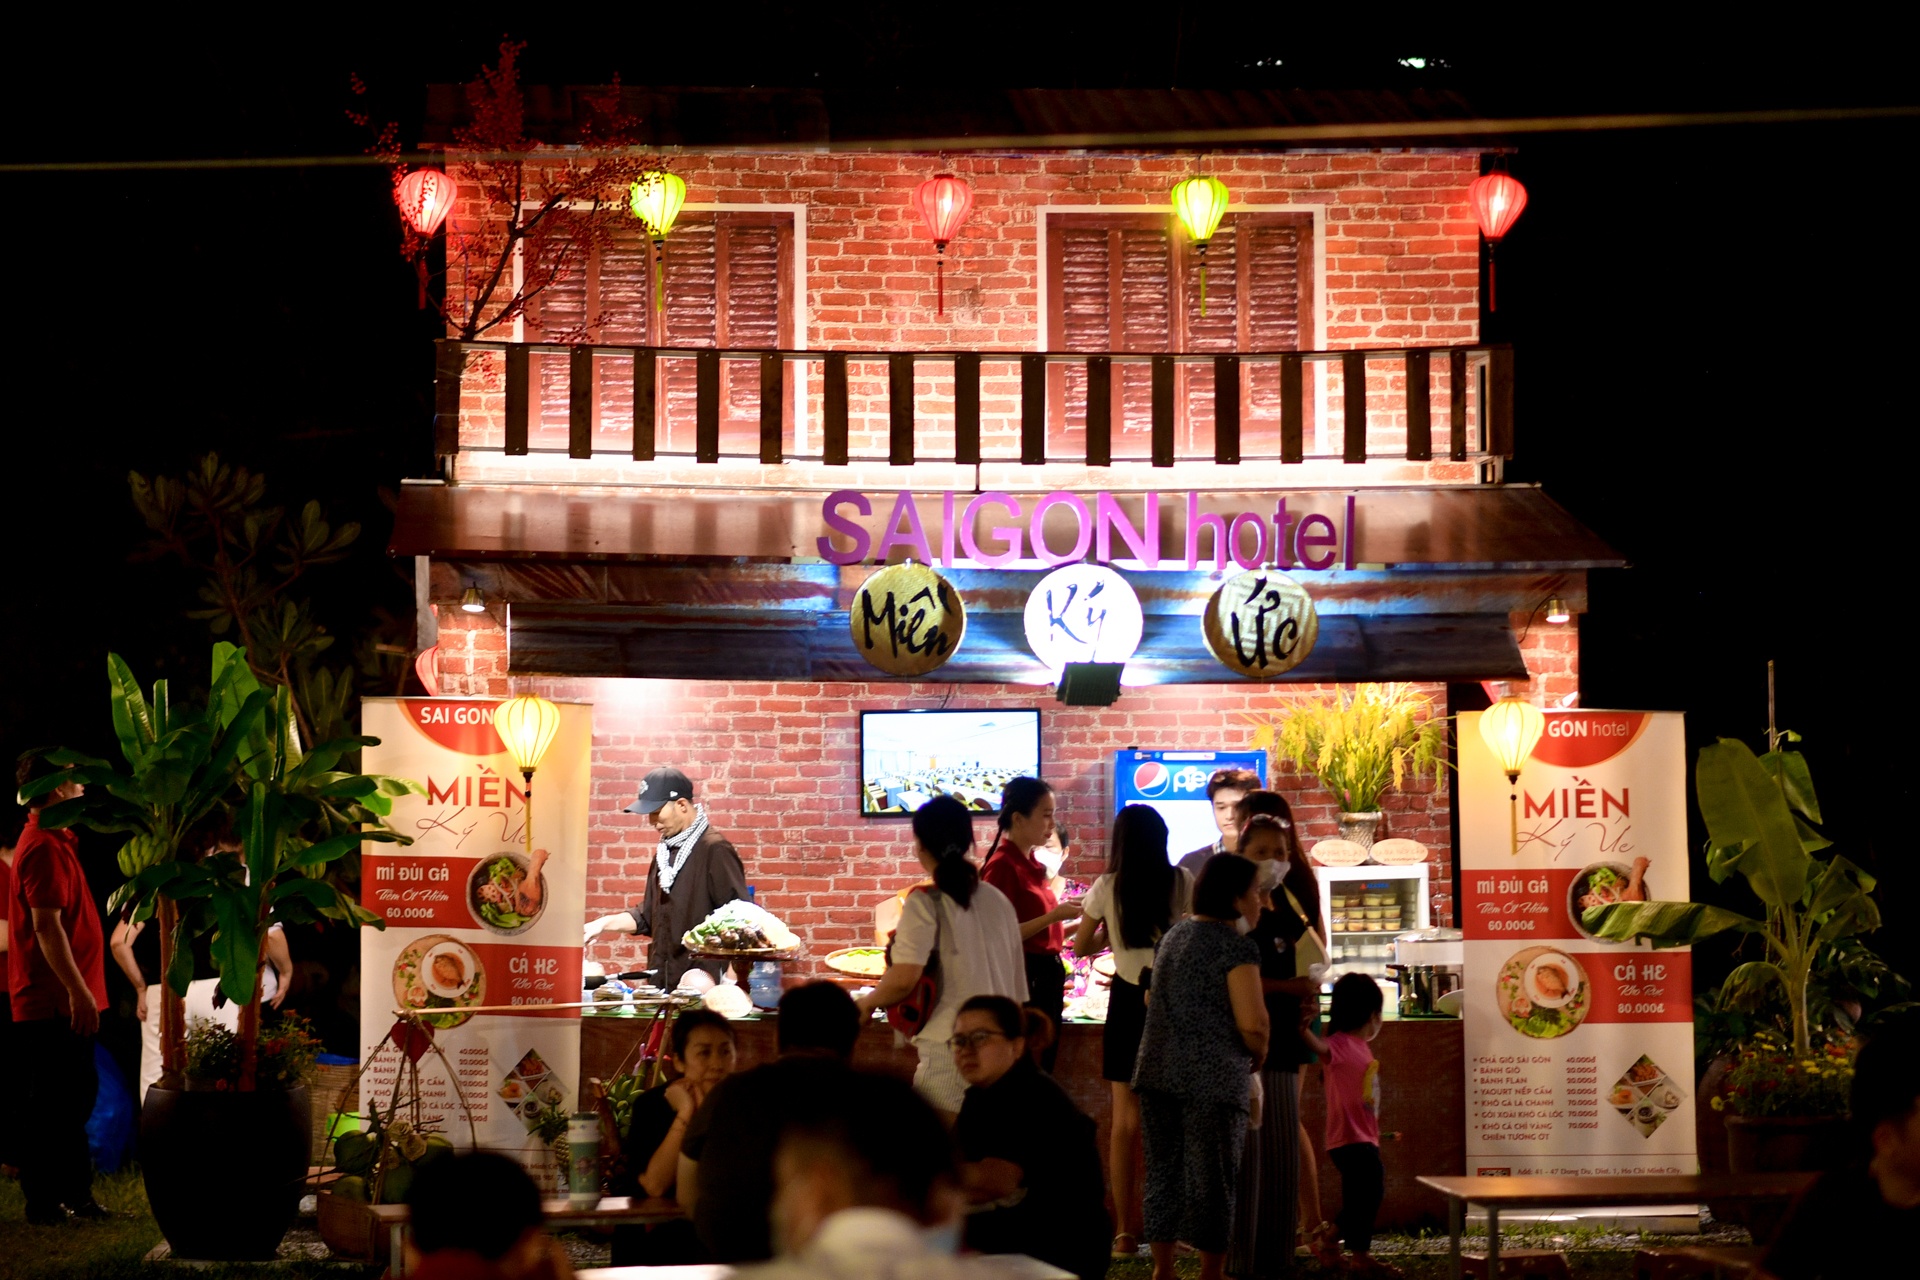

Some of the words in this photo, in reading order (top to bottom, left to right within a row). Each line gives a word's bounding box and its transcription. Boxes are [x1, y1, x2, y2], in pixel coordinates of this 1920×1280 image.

[817, 490, 1159, 569] SAIGON
[1184, 491, 1355, 571] hotel
[861, 580, 955, 658] Miền
[420, 706, 450, 725] SAI
[454, 707, 496, 726] GON
[1547, 720, 1588, 737] GON
[1592, 721, 1630, 737] hotel
[1524, 775, 1630, 819] MIỀN
[509, 952, 529, 974] CÁ
[1613, 959, 1636, 981] CÁ
